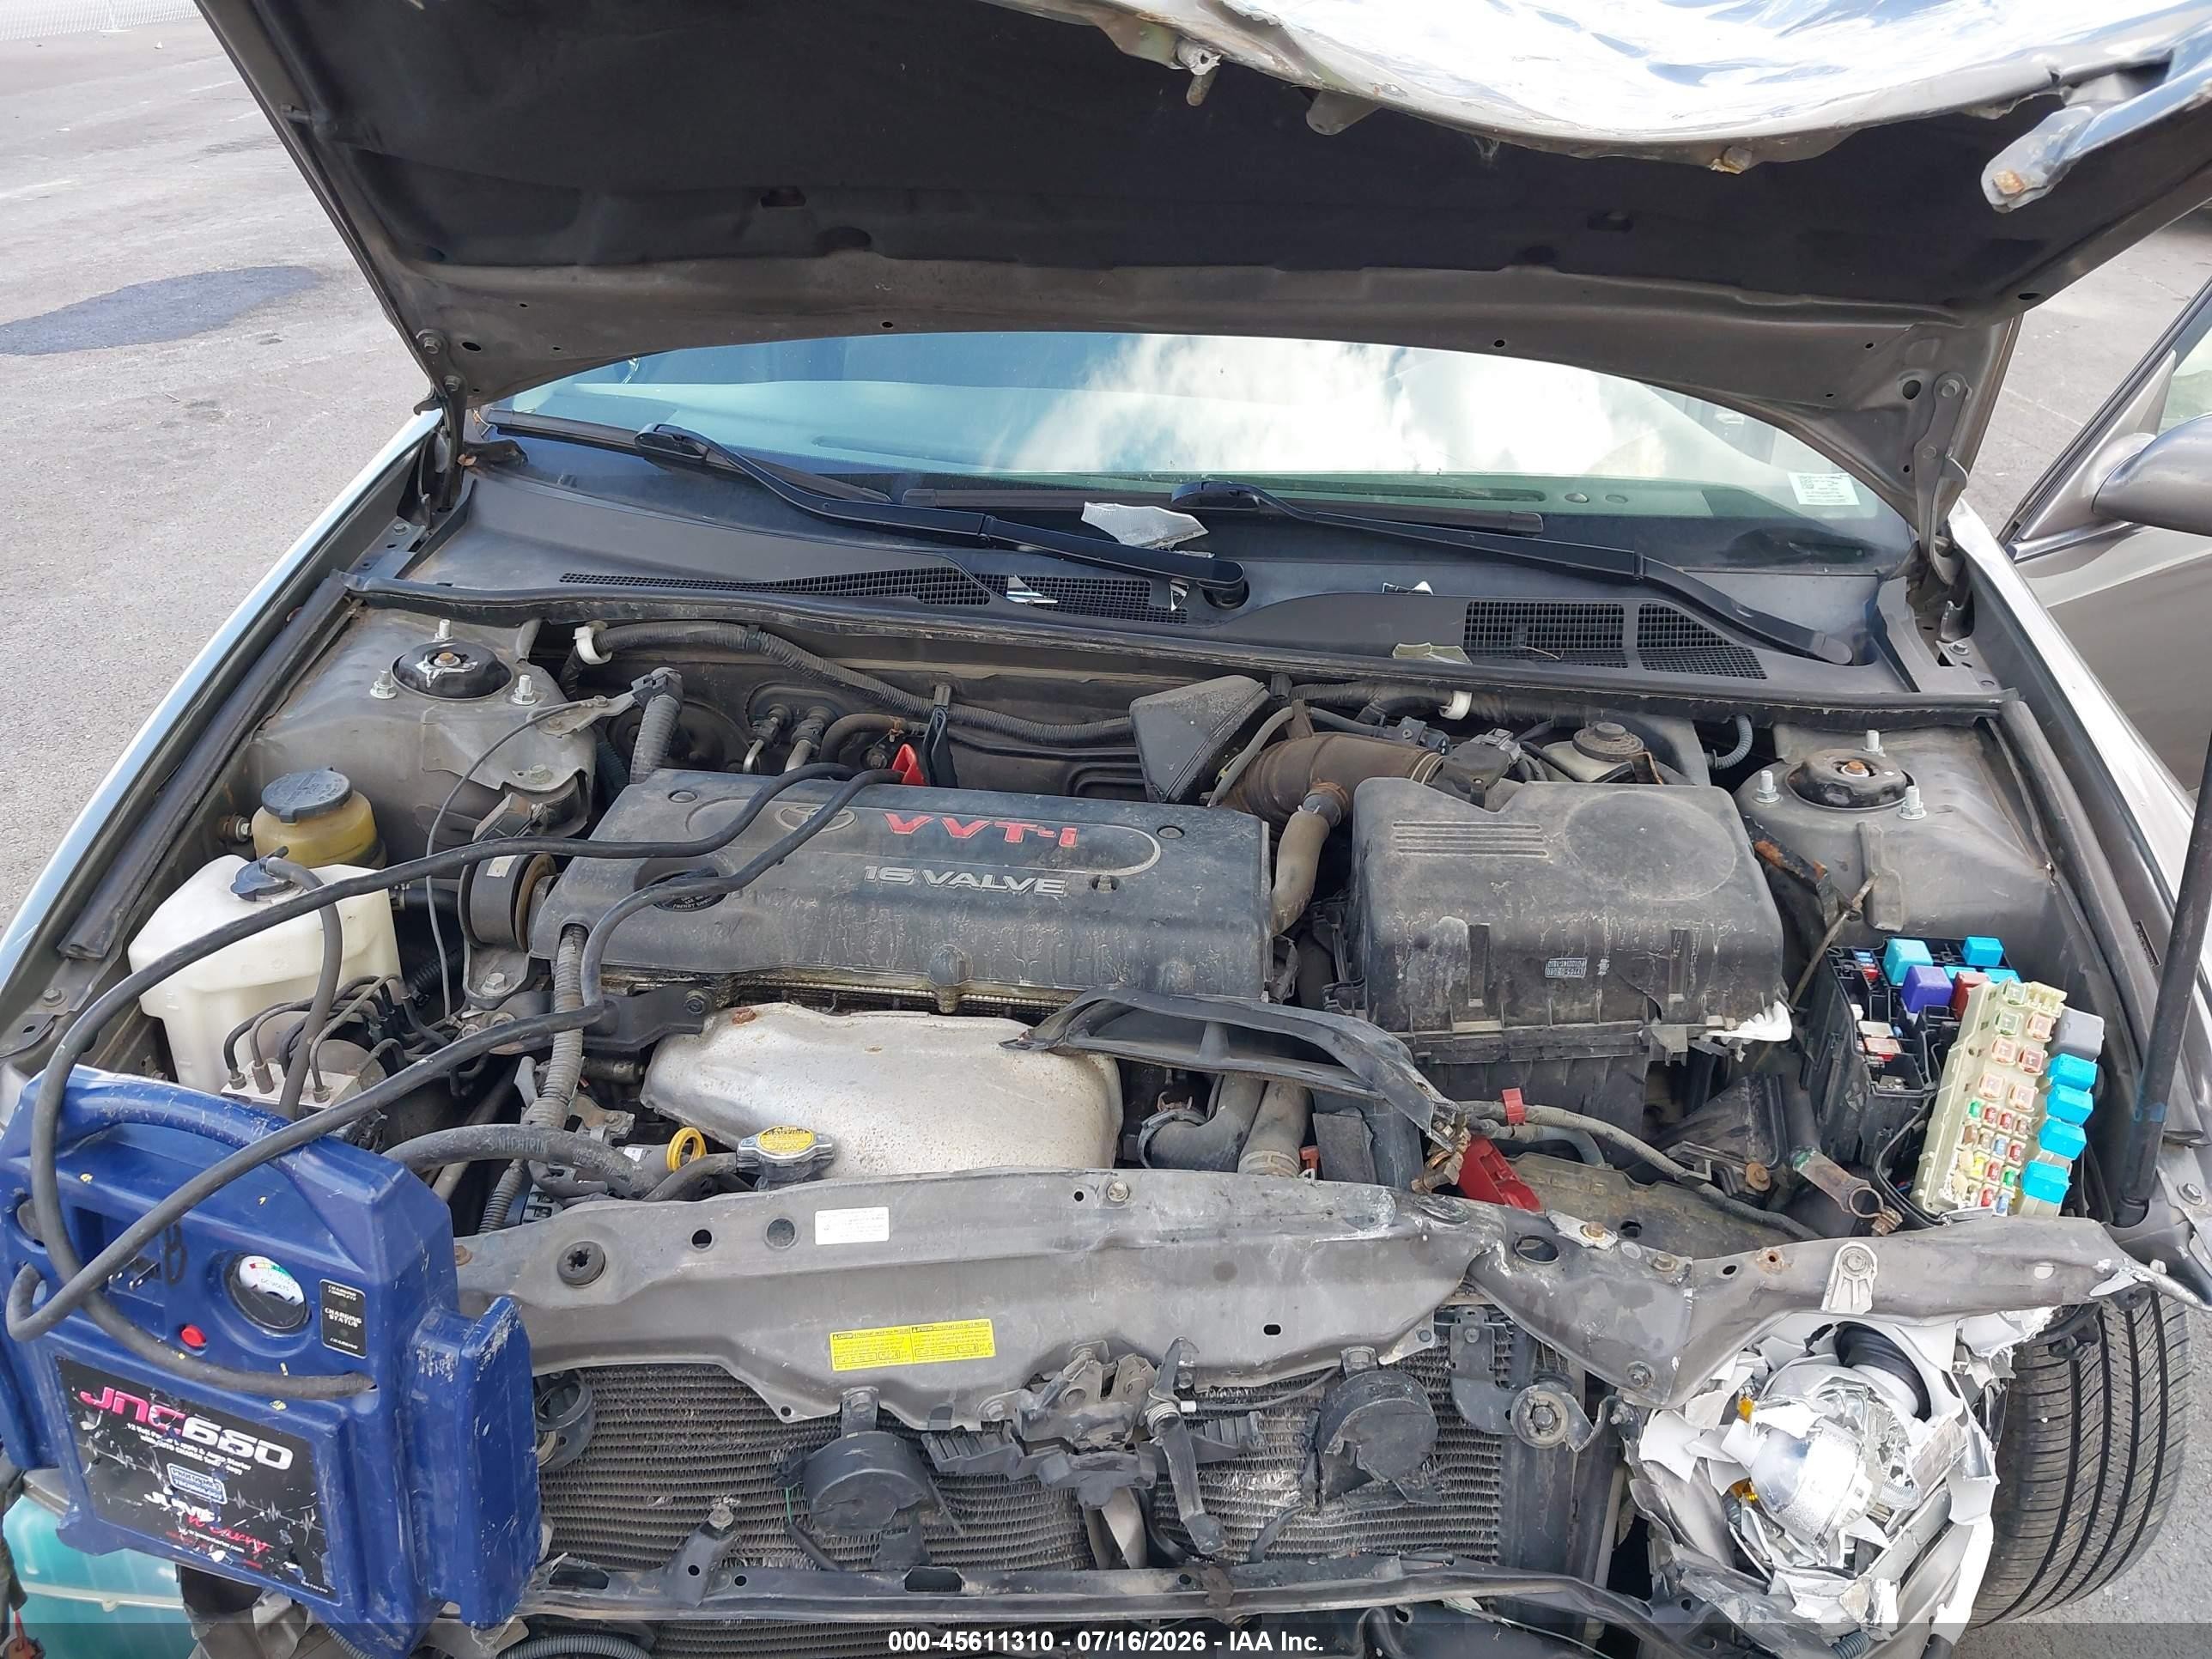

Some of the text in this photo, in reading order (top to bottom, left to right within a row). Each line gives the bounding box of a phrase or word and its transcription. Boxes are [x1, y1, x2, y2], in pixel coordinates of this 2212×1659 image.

[865, 865, 1066, 896] 16 VALVE
[325, 1307, 362, 1324] CHARGING
[328, 1314, 359, 1328] STATUS
[175, 1446, 204, 1462] CHARGE
[226, 1456, 252, 1472] Starter
